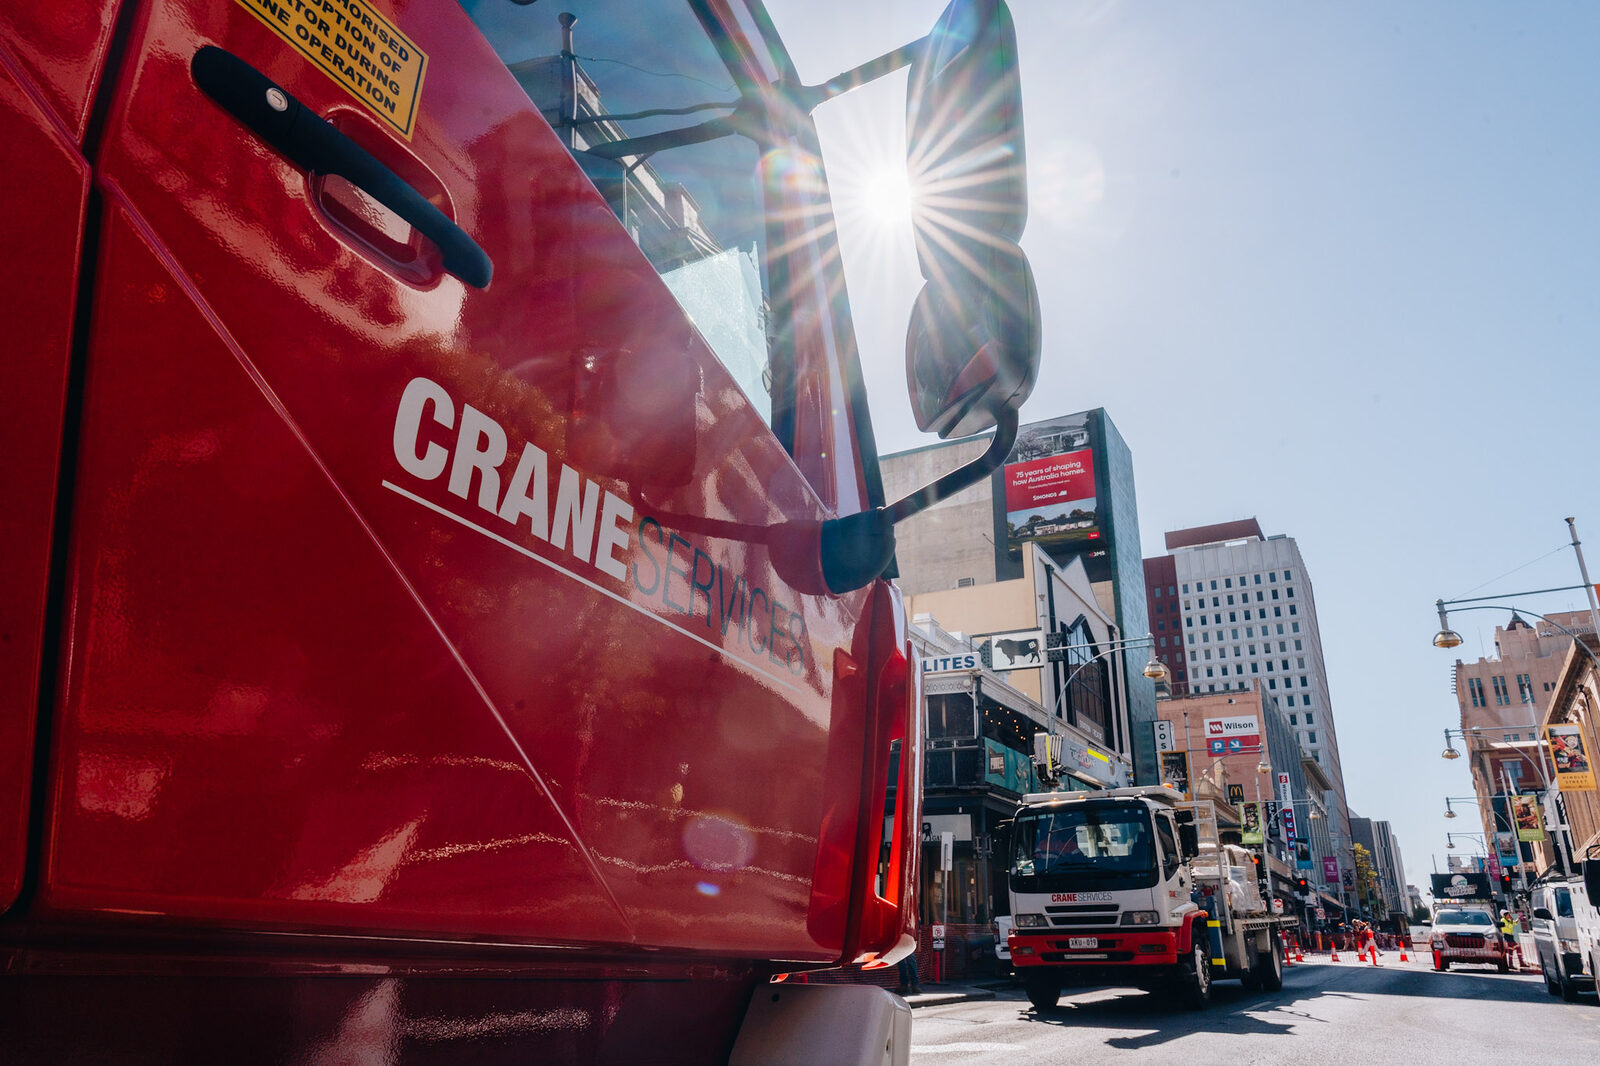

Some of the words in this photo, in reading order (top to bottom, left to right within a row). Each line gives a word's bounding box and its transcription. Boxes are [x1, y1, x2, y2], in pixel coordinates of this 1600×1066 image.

[256, 0, 291, 27] NE
[296, 24, 396, 114] OPERATION
[287, 0, 330, 37] TOR
[335, 33, 400, 96] DURING
[380, 52, 402, 73] OF
[1025, 469, 1043, 478] years
[1053, 461, 1081, 471] shaping
[1012, 479, 1027, 487] how
[1028, 472, 1059, 484] Australia
[393, 376, 635, 582] CRANE
[632, 516, 806, 676] SERVICES
[923, 656, 975, 672] LITES
[1224, 722, 1253, 730] Wilson
[1158, 723, 1167, 750] COS
[1051, 893, 1077, 903] CRANE
[1077, 892, 1112, 902] SERVICES
